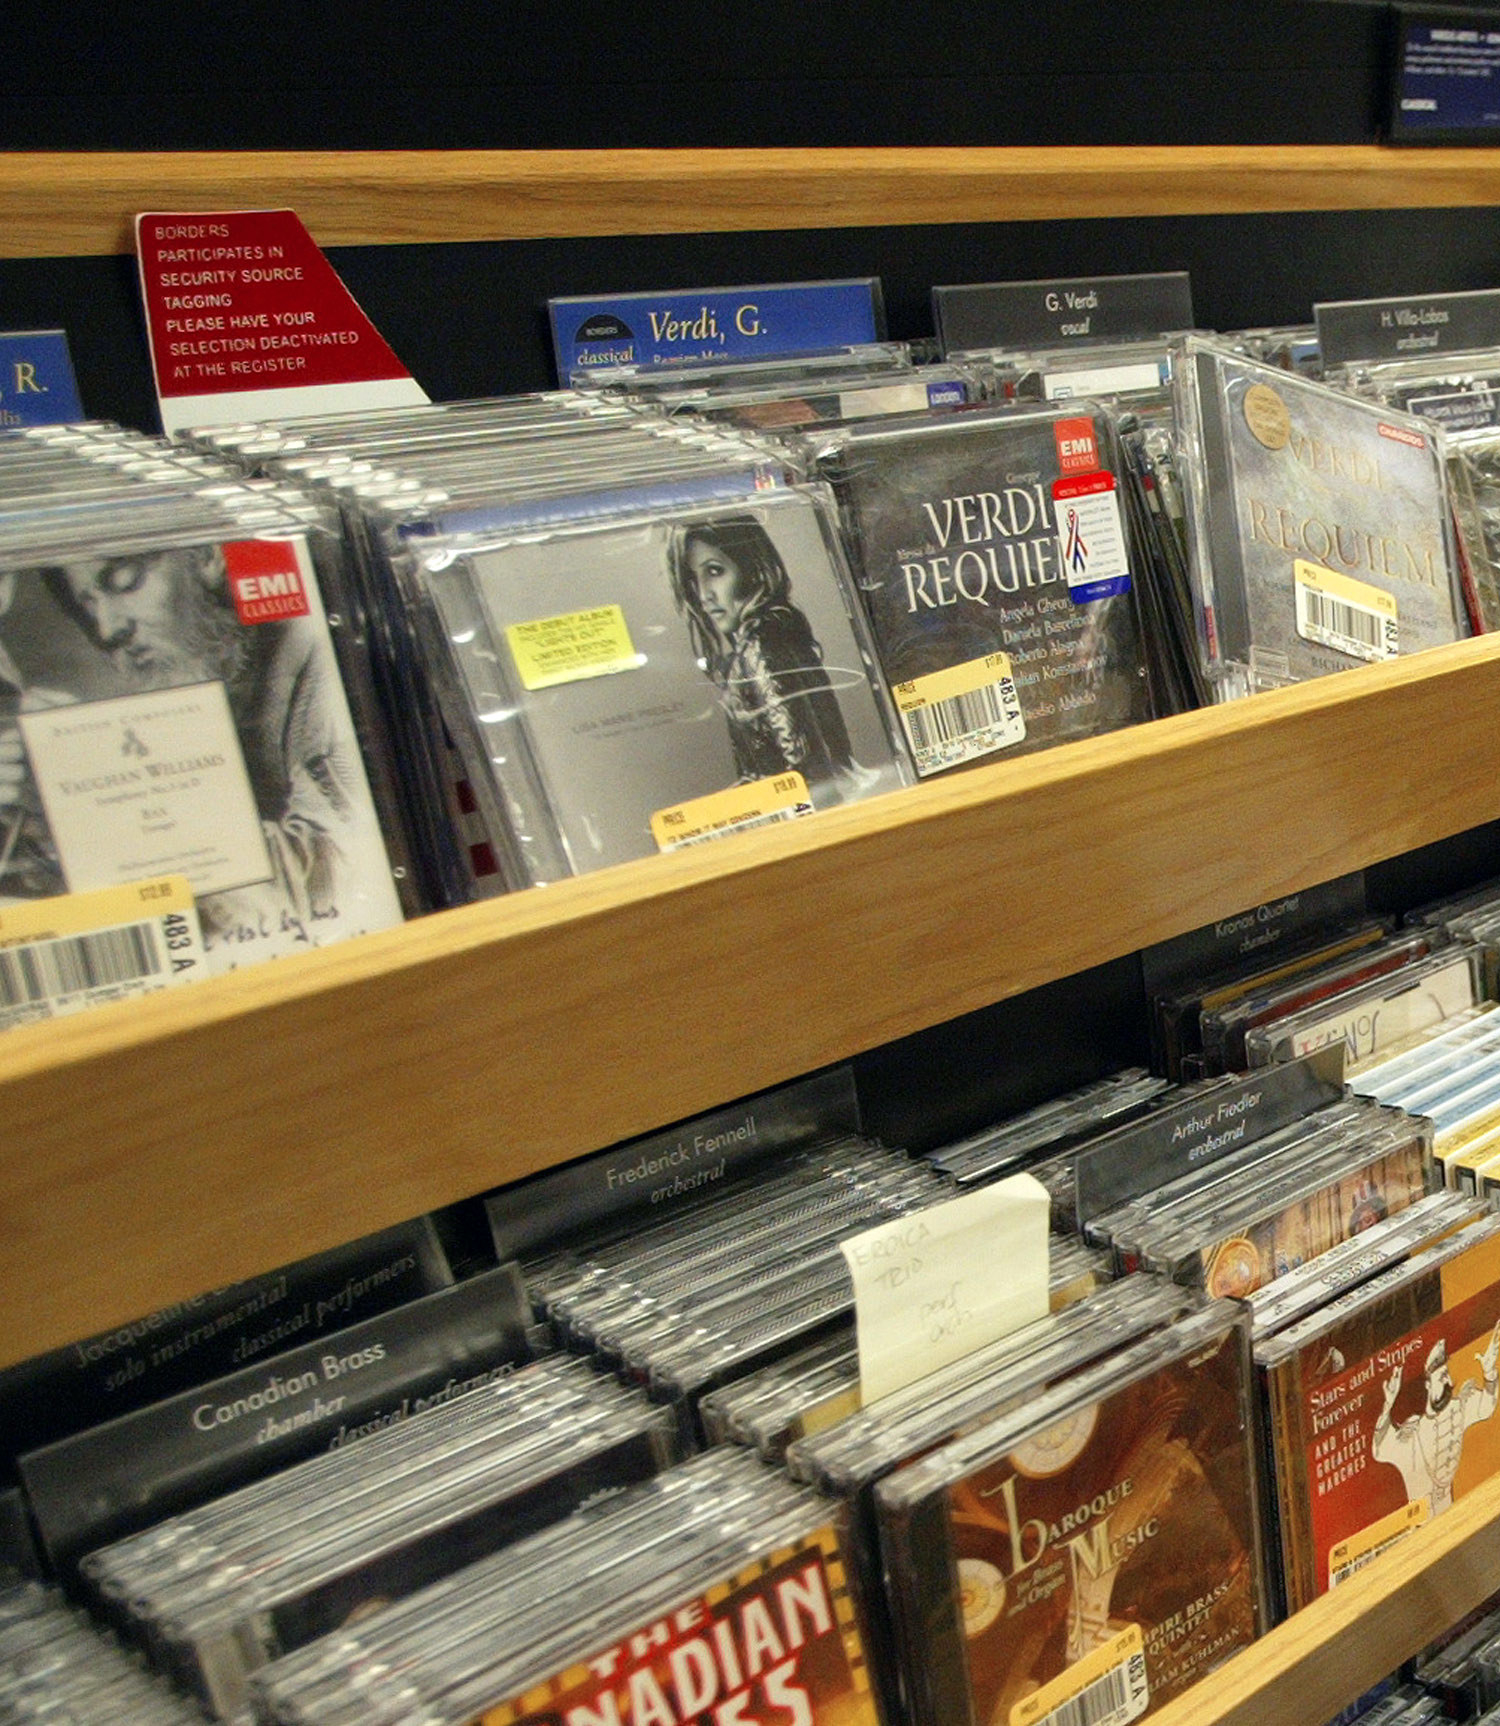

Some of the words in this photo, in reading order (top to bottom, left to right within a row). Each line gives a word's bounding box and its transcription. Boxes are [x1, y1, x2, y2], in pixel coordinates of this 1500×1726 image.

[154, 223, 230, 240] BORDERS
[157, 245, 264, 262] PARTICIPATES
[268, 245, 284, 258] IN
[160, 269, 236, 287] SECURITY
[241, 266, 304, 283] SOURCE
[164, 292, 232, 310] TAGGING
[1045, 292, 1063, 312] G.
[1064, 290, 1098, 309] Verdi
[166, 316, 225, 333] PLEASE
[229, 313, 270, 330] HAVE
[273, 311, 316, 326] YOUR
[648, 306, 726, 345] Verdi,
[735, 304, 768, 336] G.
[169, 339, 256, 356] SELECTION
[260, 330, 360, 350] DEACTIVATED
[577, 345, 634, 366] classical
[14, 362, 49, 394] R.
[173, 365, 192, 379] AT
[198, 361, 226, 376] THE
[231, 356, 306, 374] REGISTER
[1060, 437, 1093, 456] EMI
[1289, 435, 1383, 490] VERDI
[922, 483, 1052, 548] VERDI
[1248, 498, 1437, 587] REQUIEM
[236, 572, 299, 602] EMI
[243, 598, 306, 618] CLASSICS
[1005, 710, 1020, 722] A
[145, 753, 226, 778] WILLIAMS
[163, 913, 192, 951] 483
[172, 957, 197, 974] A
[1171, 1112, 1216, 1144] Arthur
[605, 1143, 693, 1190] Frederick
[693, 1116, 757, 1157] Fennell
[651, 1159, 727, 1204] orchestral
[313, 1254, 417, 1326] performers
[151, 1276, 288, 1367] instrumental
[193, 1370, 318, 1431] Canadian
[321, 1342, 387, 1381] Brass
[1310, 1382, 1347, 1414] Stars
[1349, 1358, 1376, 1391] and
[1377, 1335, 1424, 1373] Stripes
[255, 1395, 347, 1445] chamber
[1312, 1393, 1366, 1436] Forever
[1315, 1435, 1337, 1461] AND
[1342, 1418, 1362, 1443] THE
[1316, 1434, 1367, 1479] GREATEST
[1318, 1454, 1367, 1497] MARCHES
[1185, 1581, 1230, 1616] BRASS
[563, 1562, 834, 1726] NADIAN
[590, 1602, 704, 1680] THE
[1149, 1607, 1212, 1656] QUINTET
[1181, 1626, 1242, 1673] KUHLMAN
[1127, 1653, 1145, 1684] 483
[1131, 1690, 1146, 1701] A
